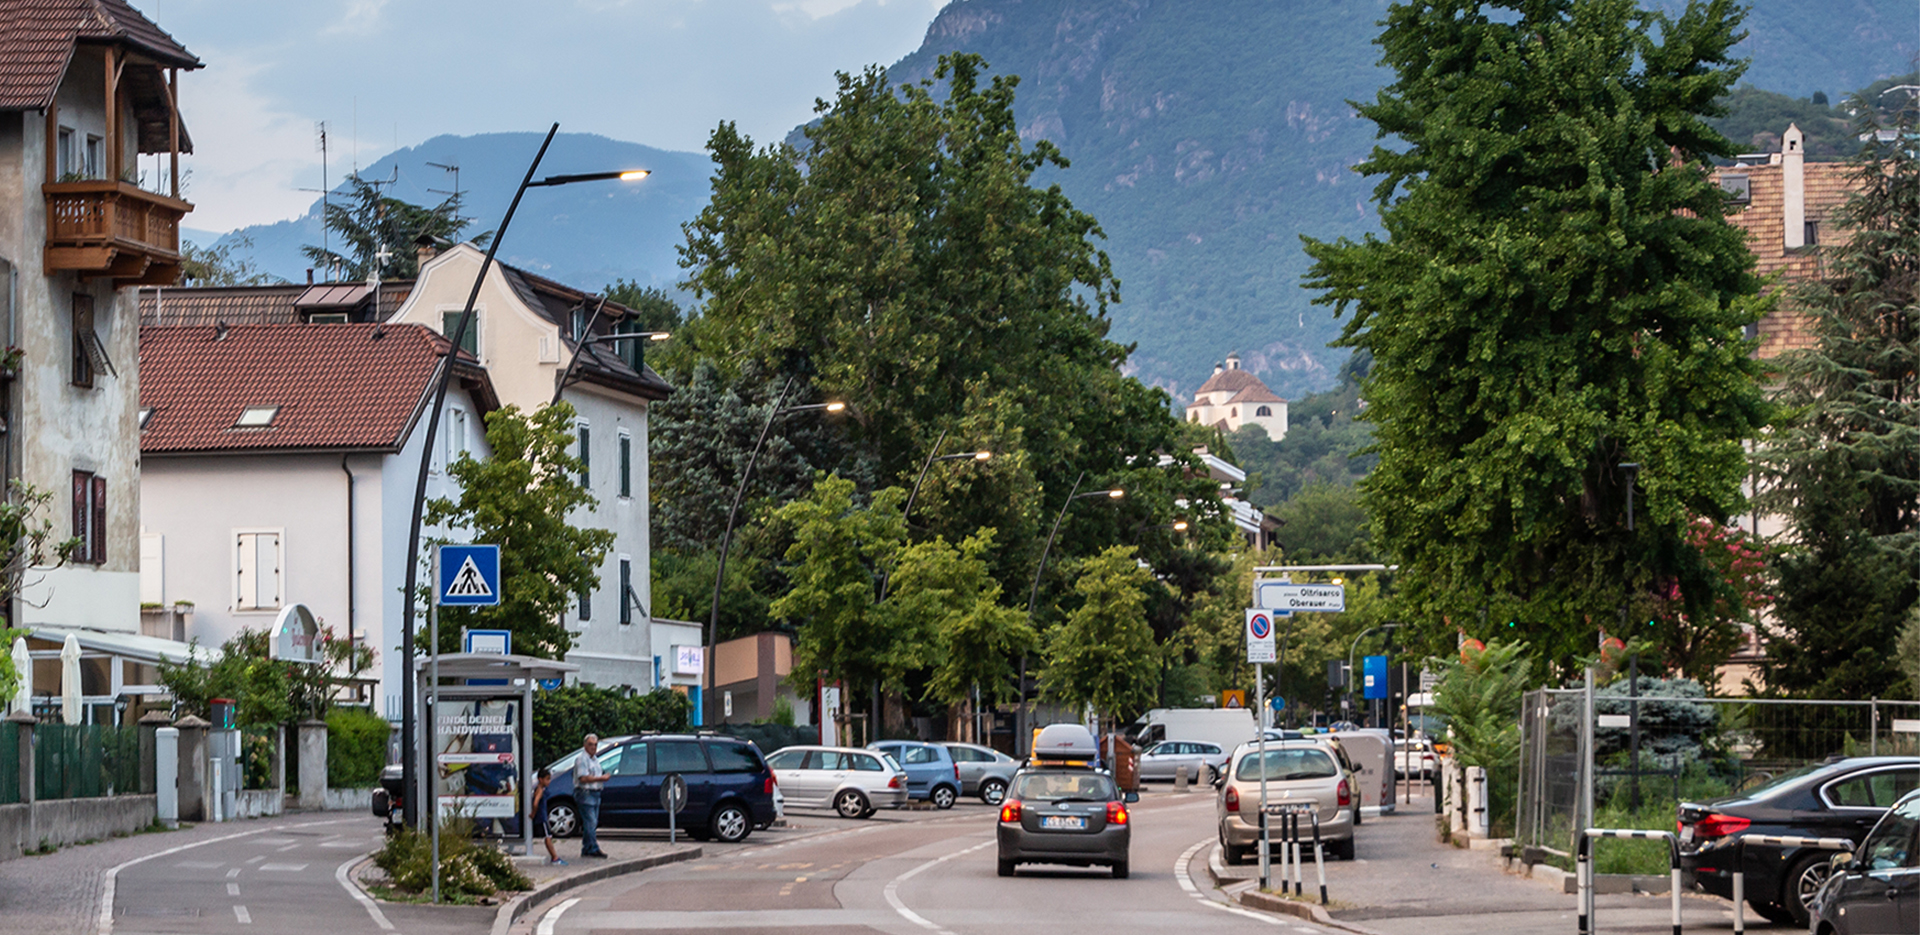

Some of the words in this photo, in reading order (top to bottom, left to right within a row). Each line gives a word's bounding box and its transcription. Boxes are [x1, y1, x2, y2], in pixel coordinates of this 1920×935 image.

[1300, 588, 1340, 597] Oltrisarco
[1289, 598, 1326, 607] Oberauer
[437, 715, 467, 725] FINDE
[468, 715, 506, 725] DEINEN
[437, 725, 514, 735] HANDWERKER
